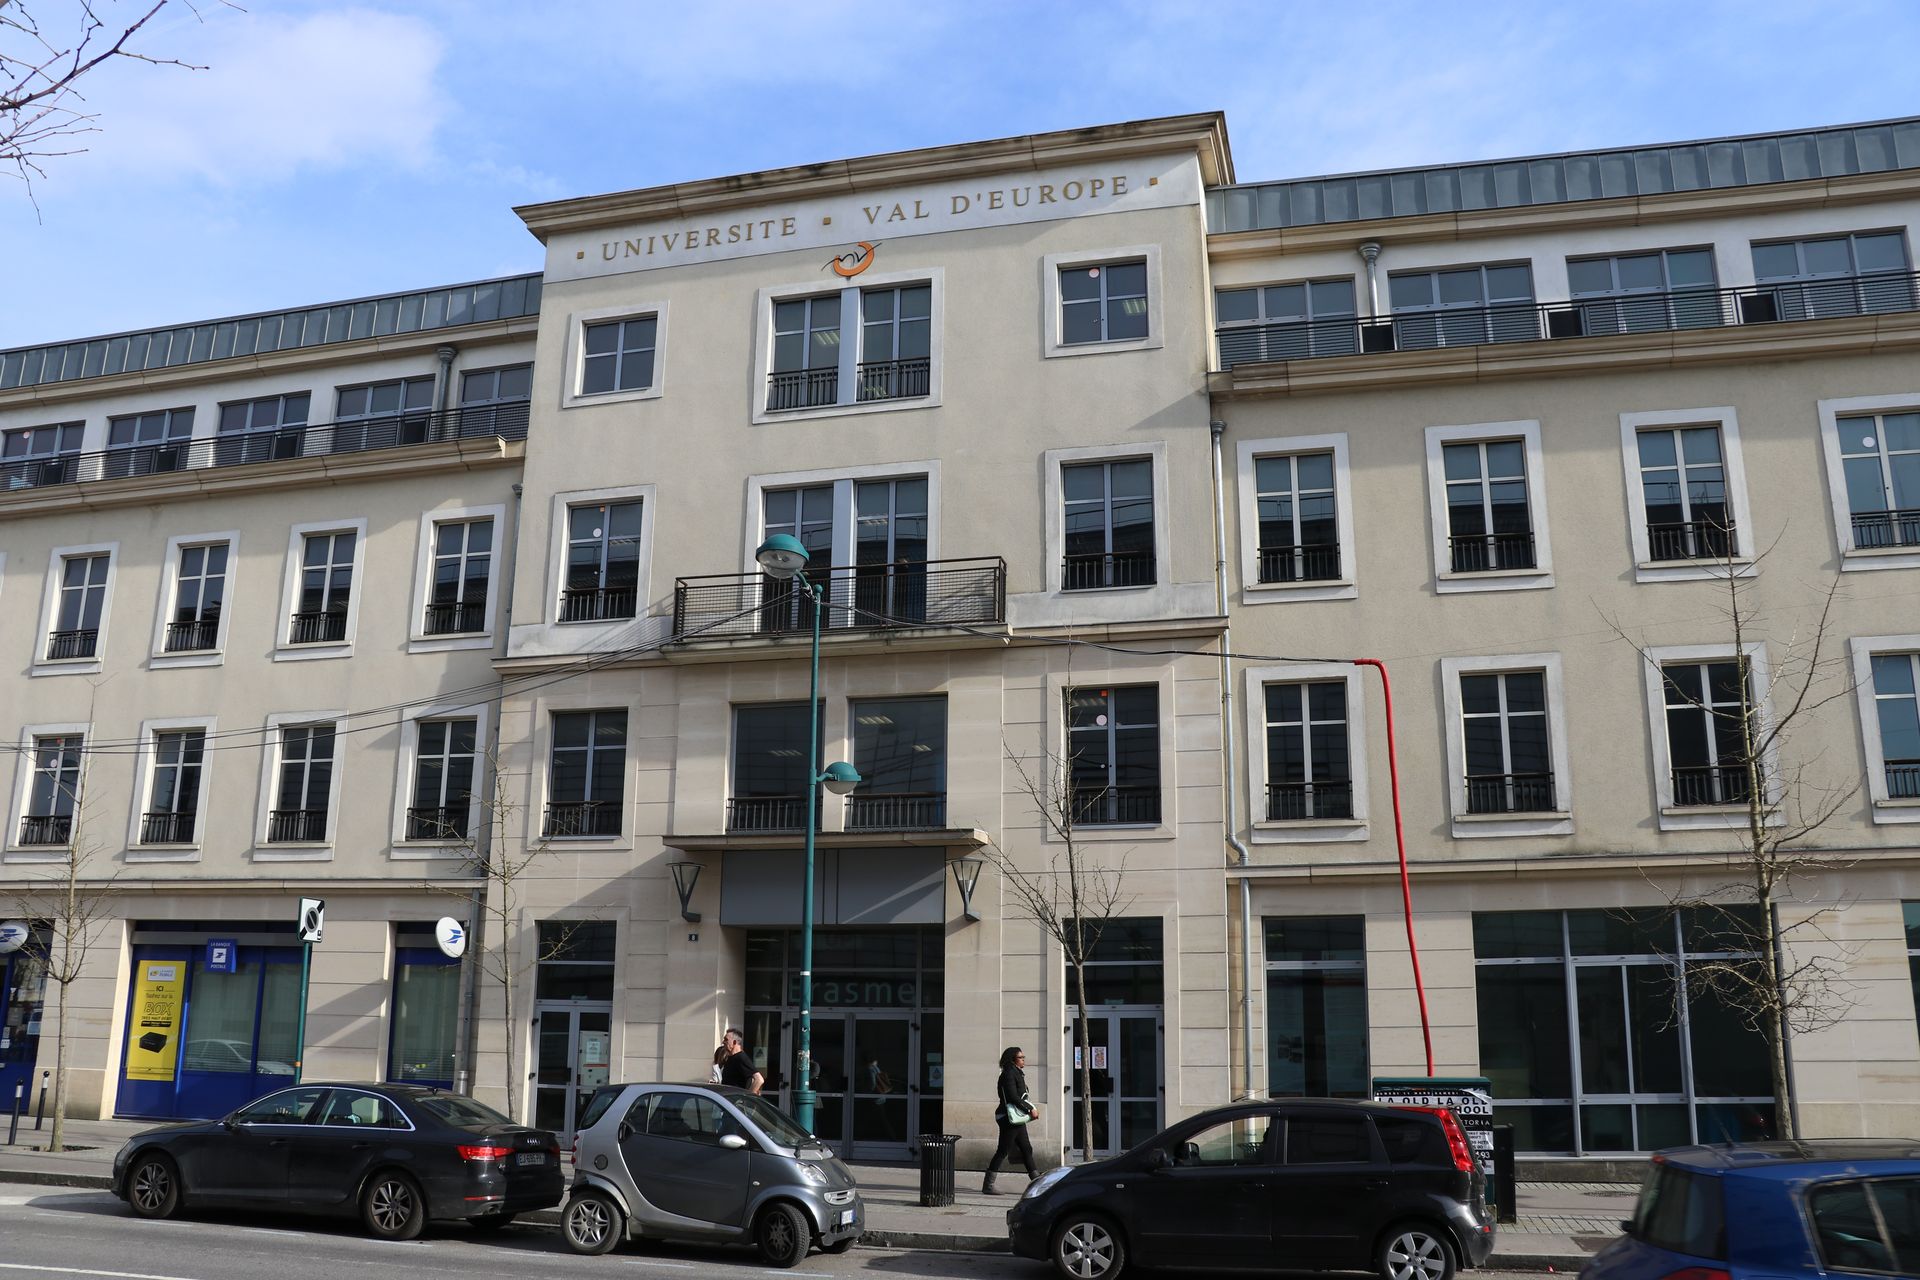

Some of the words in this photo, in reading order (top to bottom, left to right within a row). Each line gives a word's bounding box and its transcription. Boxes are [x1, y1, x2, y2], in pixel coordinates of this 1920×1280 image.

[602, 217, 796, 261] UNIVERSITE
[863, 200, 930, 225] VAL
[951, 175, 1130, 214] D'EUROPE
[788, 975, 915, 1004] Erasme
[144, 1001, 175, 1016] BOX
[1402, 1097, 1430, 1105] OLD
[1437, 1097, 1454, 1105] LA
